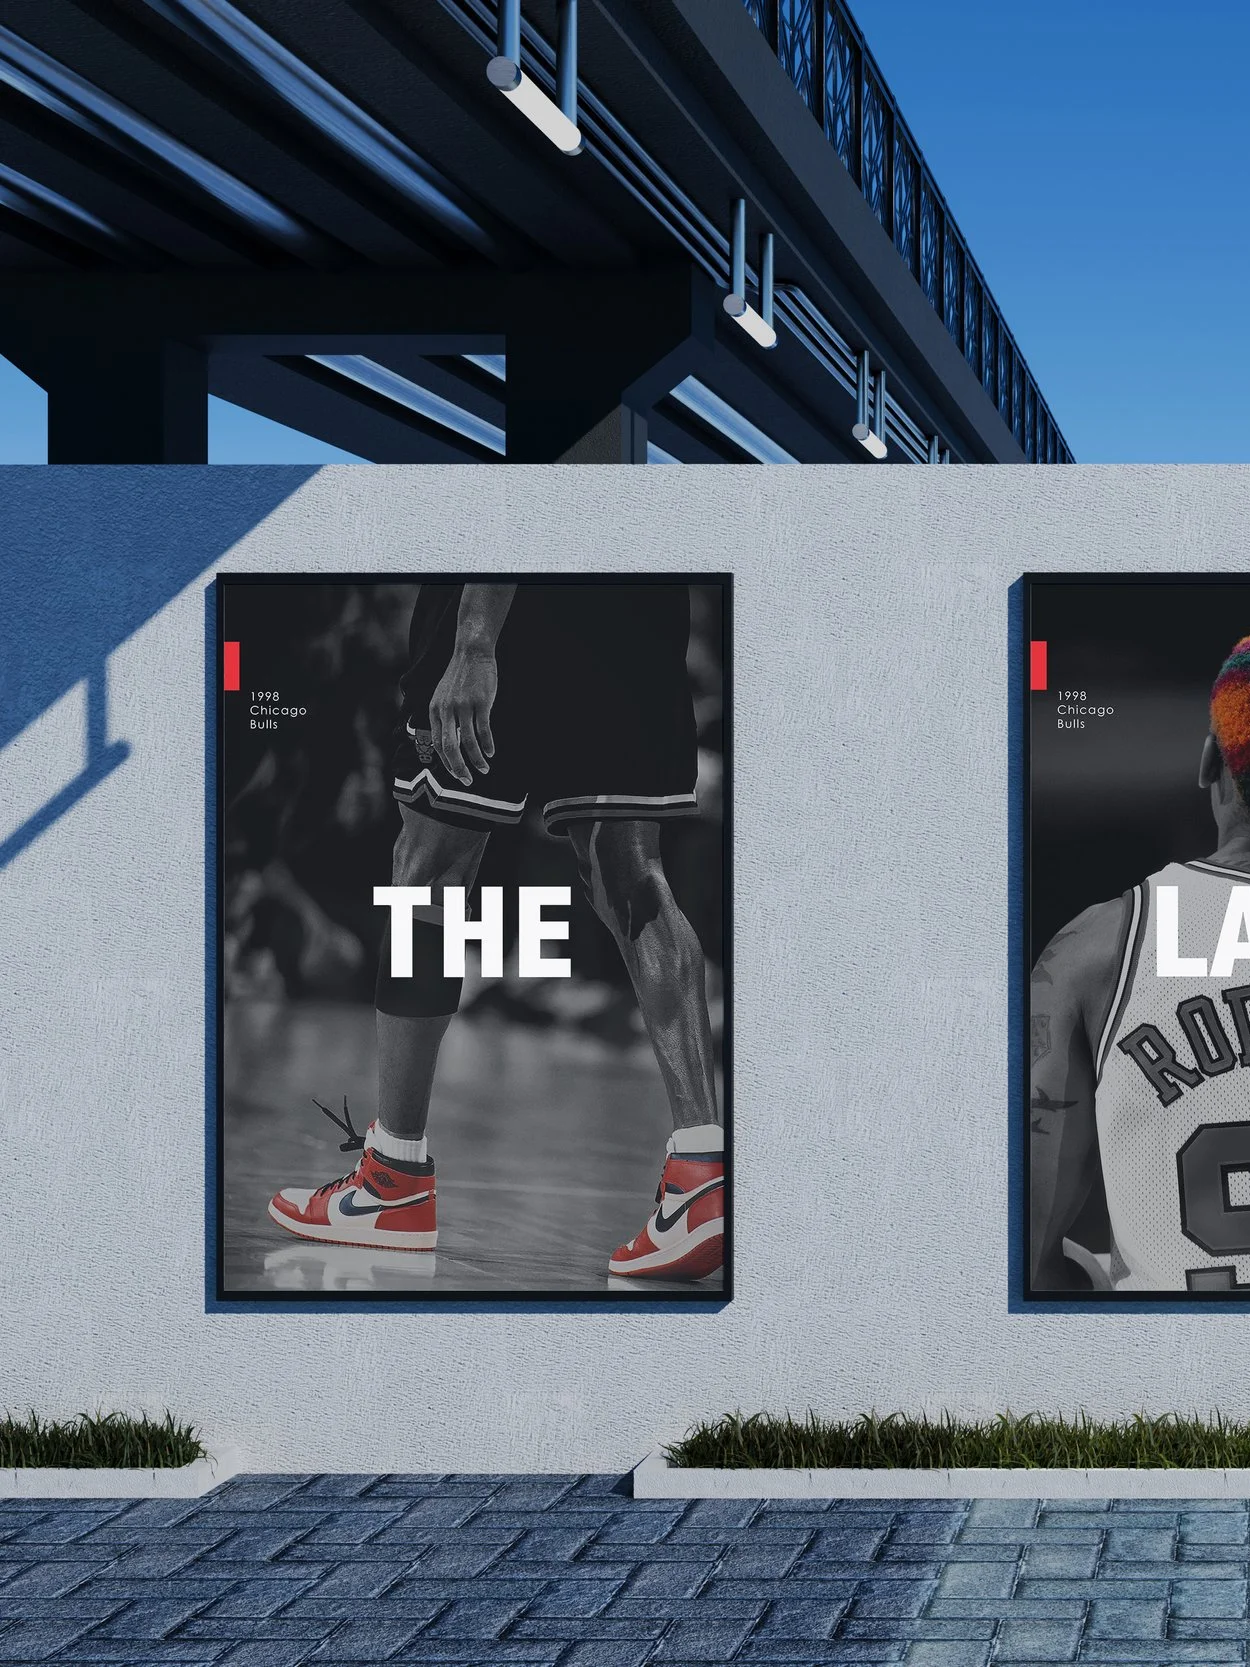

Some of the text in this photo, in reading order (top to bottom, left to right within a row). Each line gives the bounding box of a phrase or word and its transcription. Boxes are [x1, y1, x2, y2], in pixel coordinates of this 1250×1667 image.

[251, 691, 280, 702] 1998
[1058, 690, 1087, 701] 1998
[249, 705, 307, 718] Chicago
[1056, 704, 1114, 717] Chicago
[250, 719, 278, 730] Bulls
[1057, 718, 1085, 729] Bulls
[373, 886, 572, 978] THE
